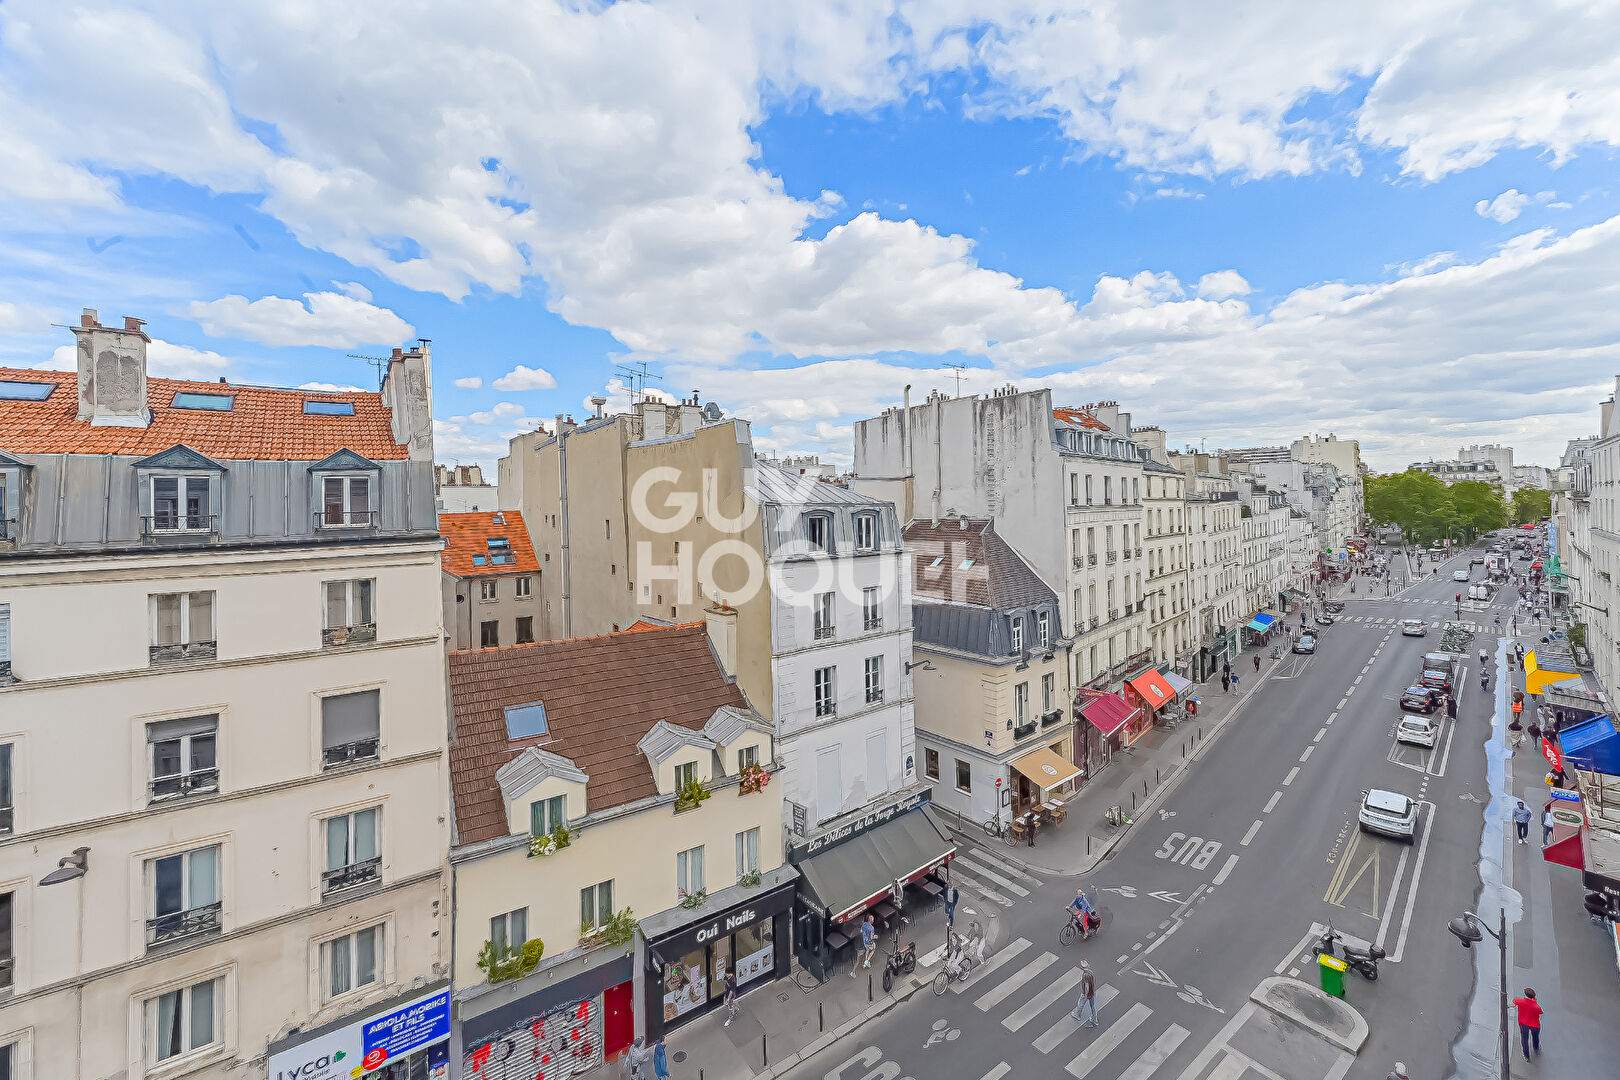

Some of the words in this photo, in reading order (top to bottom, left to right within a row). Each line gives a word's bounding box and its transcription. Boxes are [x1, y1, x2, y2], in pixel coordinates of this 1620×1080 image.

[807, 839, 822, 853] Les
[854, 818, 864, 832] de
[864, 812, 876, 827] la
[1154, 832, 1223, 871] BUS
[696, 923, 718, 942] Oui
[726, 909, 756, 931] Nails
[368, 1012, 407, 1035] ABIOLA
[391, 1021, 405, 1033] ET
[405, 1013, 425, 1028] FILS
